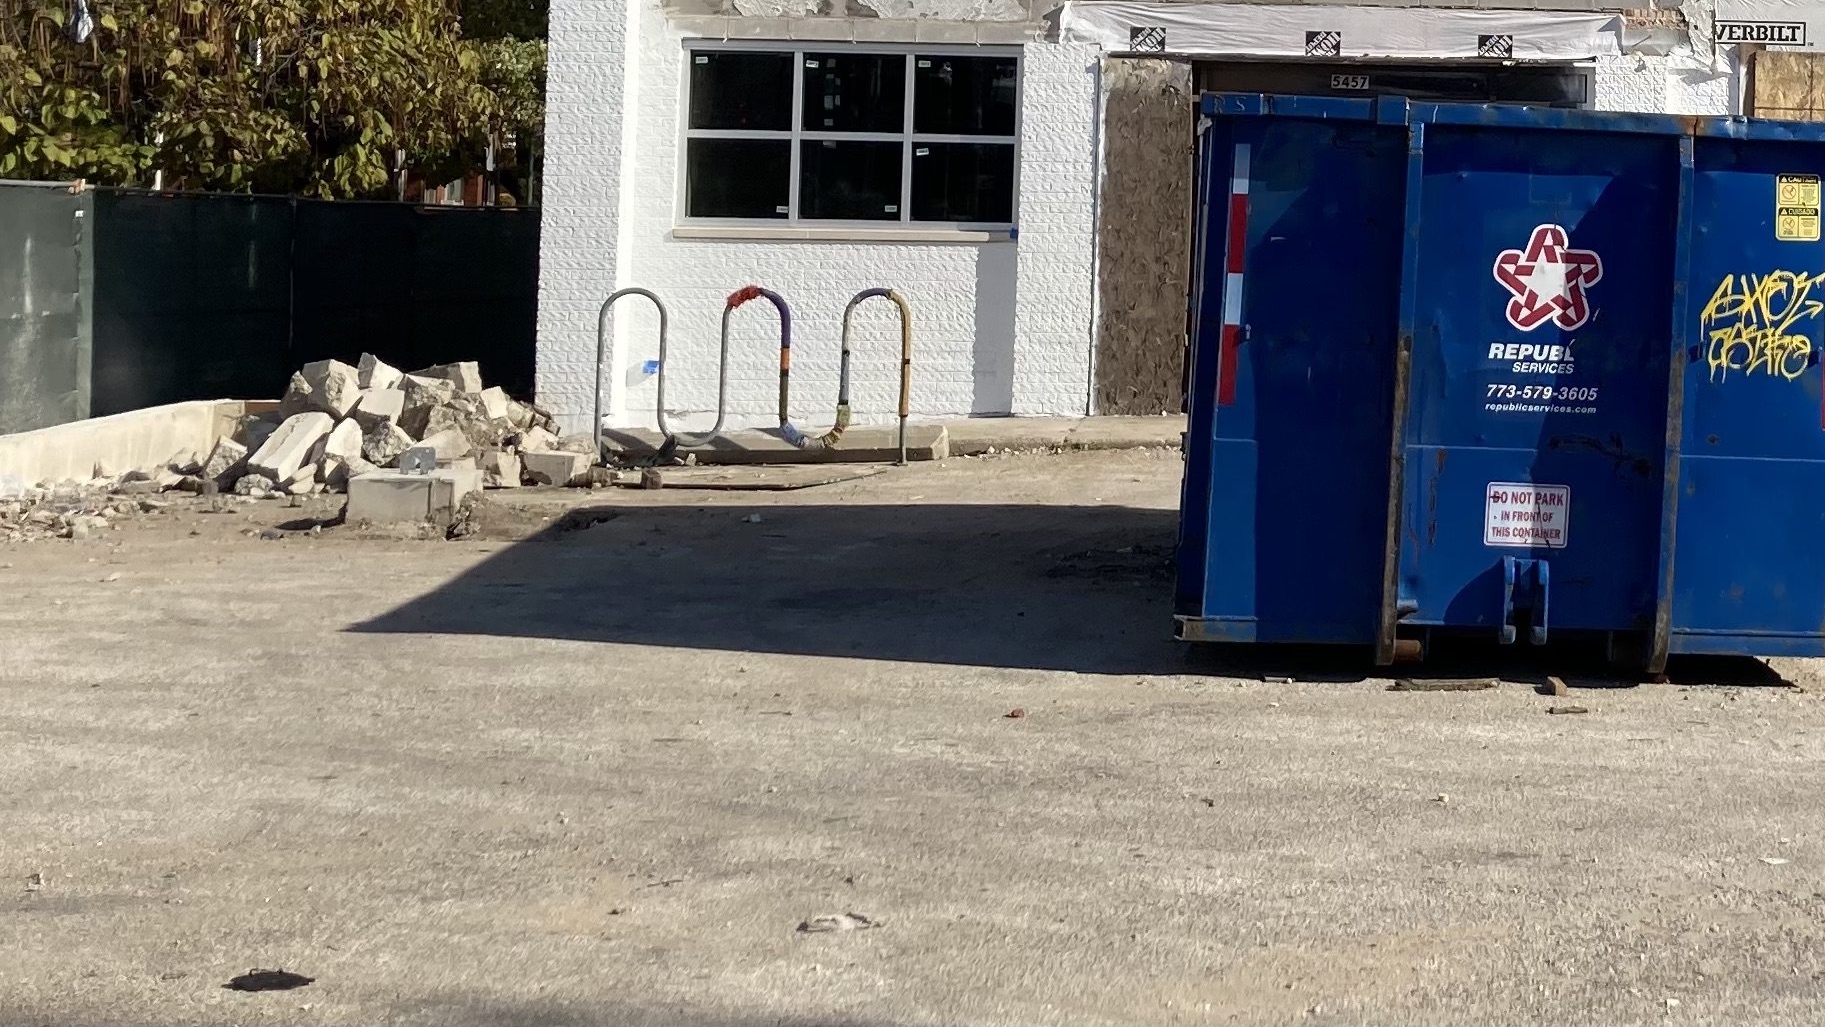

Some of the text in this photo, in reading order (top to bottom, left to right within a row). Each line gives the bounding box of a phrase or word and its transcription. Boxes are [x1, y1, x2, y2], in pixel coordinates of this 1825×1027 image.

[1715, 25, 1801, 41] VERBILT
[1332, 75, 1368, 88] 5457
[1512, 362, 1575, 374] SERVICES
[1486, 384, 1598, 401] 773-579-3605
[1484, 402, 1597, 414] republicservices.com
[1492, 491, 1564, 506] DO NOT PARK
[1501, 510, 1554, 523] IN FRONT OF
[1492, 526, 1561, 540] THIS CONTAINER
